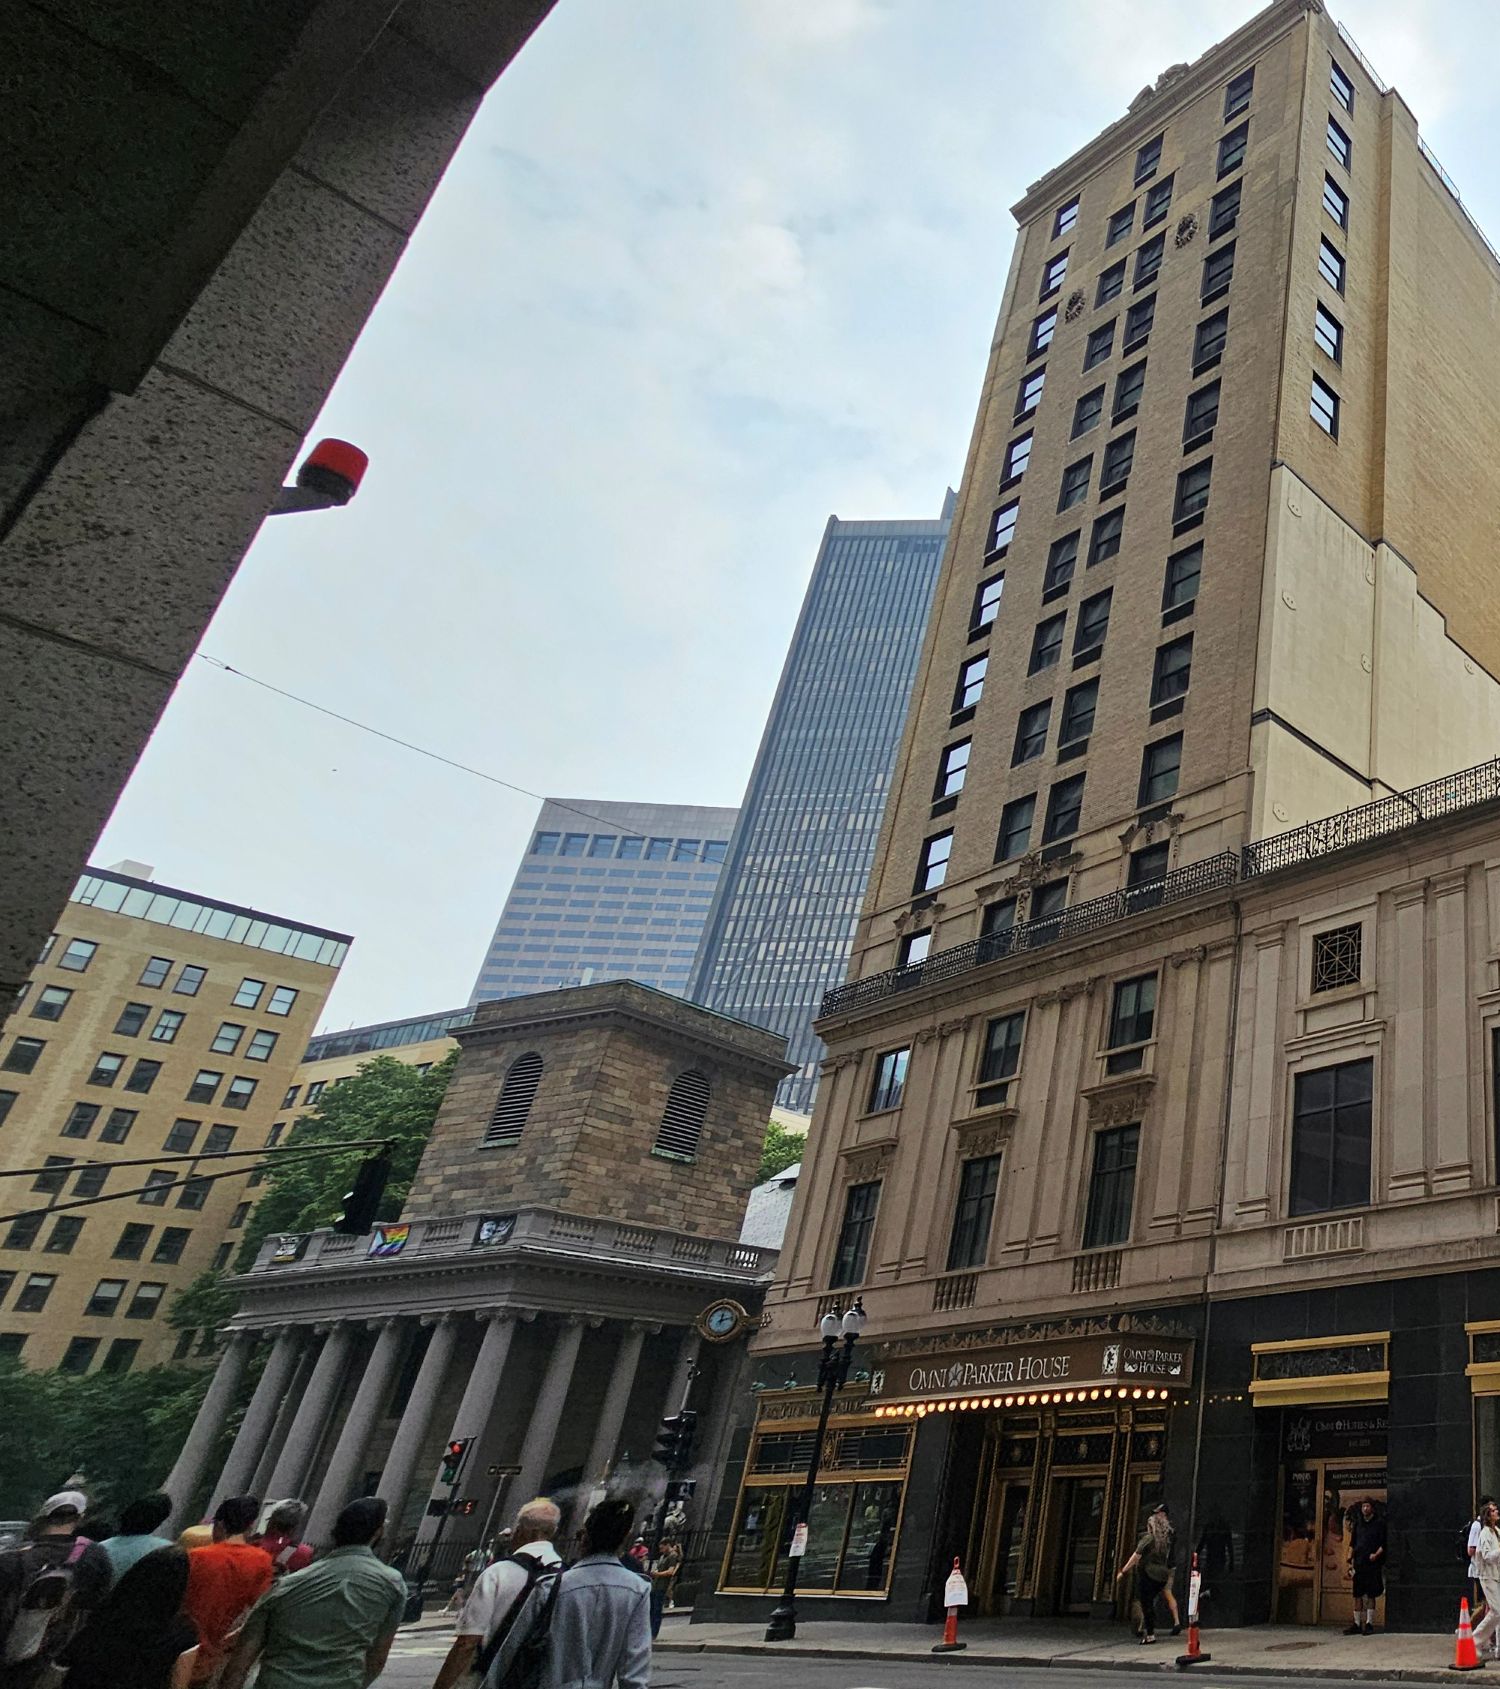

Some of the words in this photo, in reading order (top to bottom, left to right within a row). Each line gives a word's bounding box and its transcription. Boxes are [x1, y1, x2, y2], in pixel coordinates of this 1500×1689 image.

[1124, 1348, 1147, 1360] OMNI
[1155, 1350, 1184, 1363] PARKER
[908, 1367, 949, 1391] OMNI
[962, 1361, 1014, 1386] PARKER
[1016, 1355, 1071, 1381] HOUSE
[1139, 1362, 1166, 1374] HOUSE
